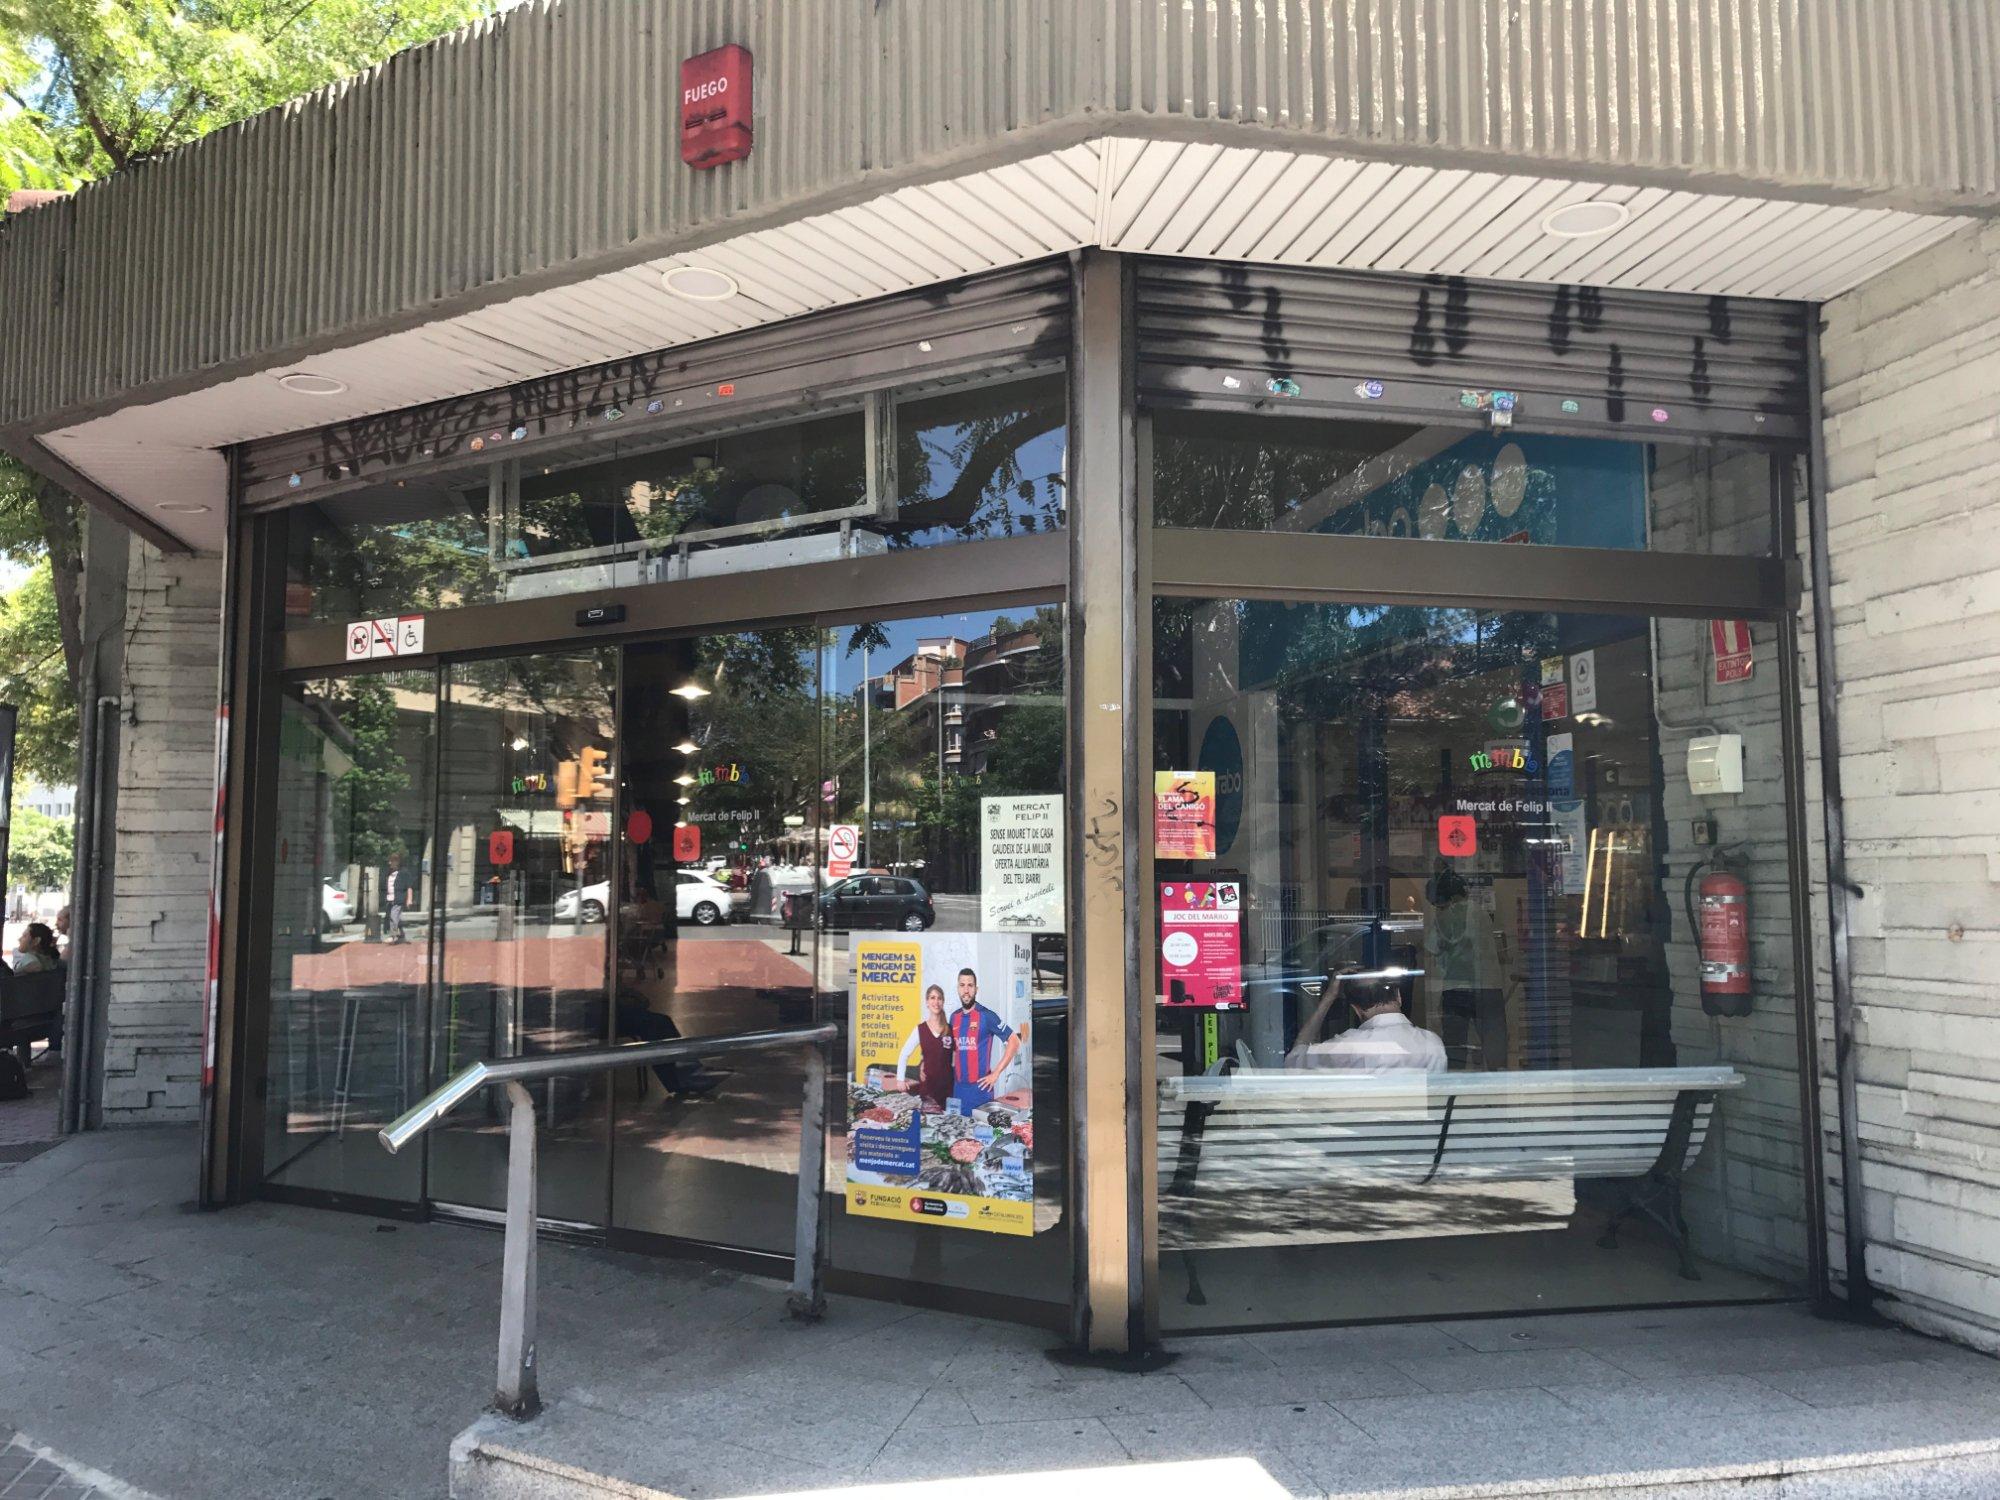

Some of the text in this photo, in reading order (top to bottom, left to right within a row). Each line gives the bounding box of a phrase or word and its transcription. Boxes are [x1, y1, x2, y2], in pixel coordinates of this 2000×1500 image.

[684, 77, 728, 105] FUEGO
[1012, 803, 1051, 811] MERCAT
[1456, 799, 1553, 814] Mercat de Felip II
[687, 809, 760, 823] Mercat de Felip II
[1015, 813, 1041, 821] FELIP
[990, 828, 1006, 840] SENSE
[1032, 828, 1039, 839] DE
[1040, 828, 1054, 839] CASA
[1016, 843, 1022, 854] DE
[1024, 843, 1031, 854] LA
[1031, 843, 1052, 854] MILLOR
[994, 858, 1014, 870] OFERTA
[1003, 873, 1041, 884] DEL TEU BARRI
[861, 953, 916, 961] MENGEM SA
[861, 963, 916, 971] MENGEM DE
[861, 972, 916, 984] MERCAT
[861, 993, 900, 1002] Activitats
[861, 1003, 904, 1012] educatives
[861, 1013, 874, 1022] per
[882, 1012, 894, 1021] les
[861, 1022, 890, 1030] escoles
[861, 1049, 876, 1057] ESO
